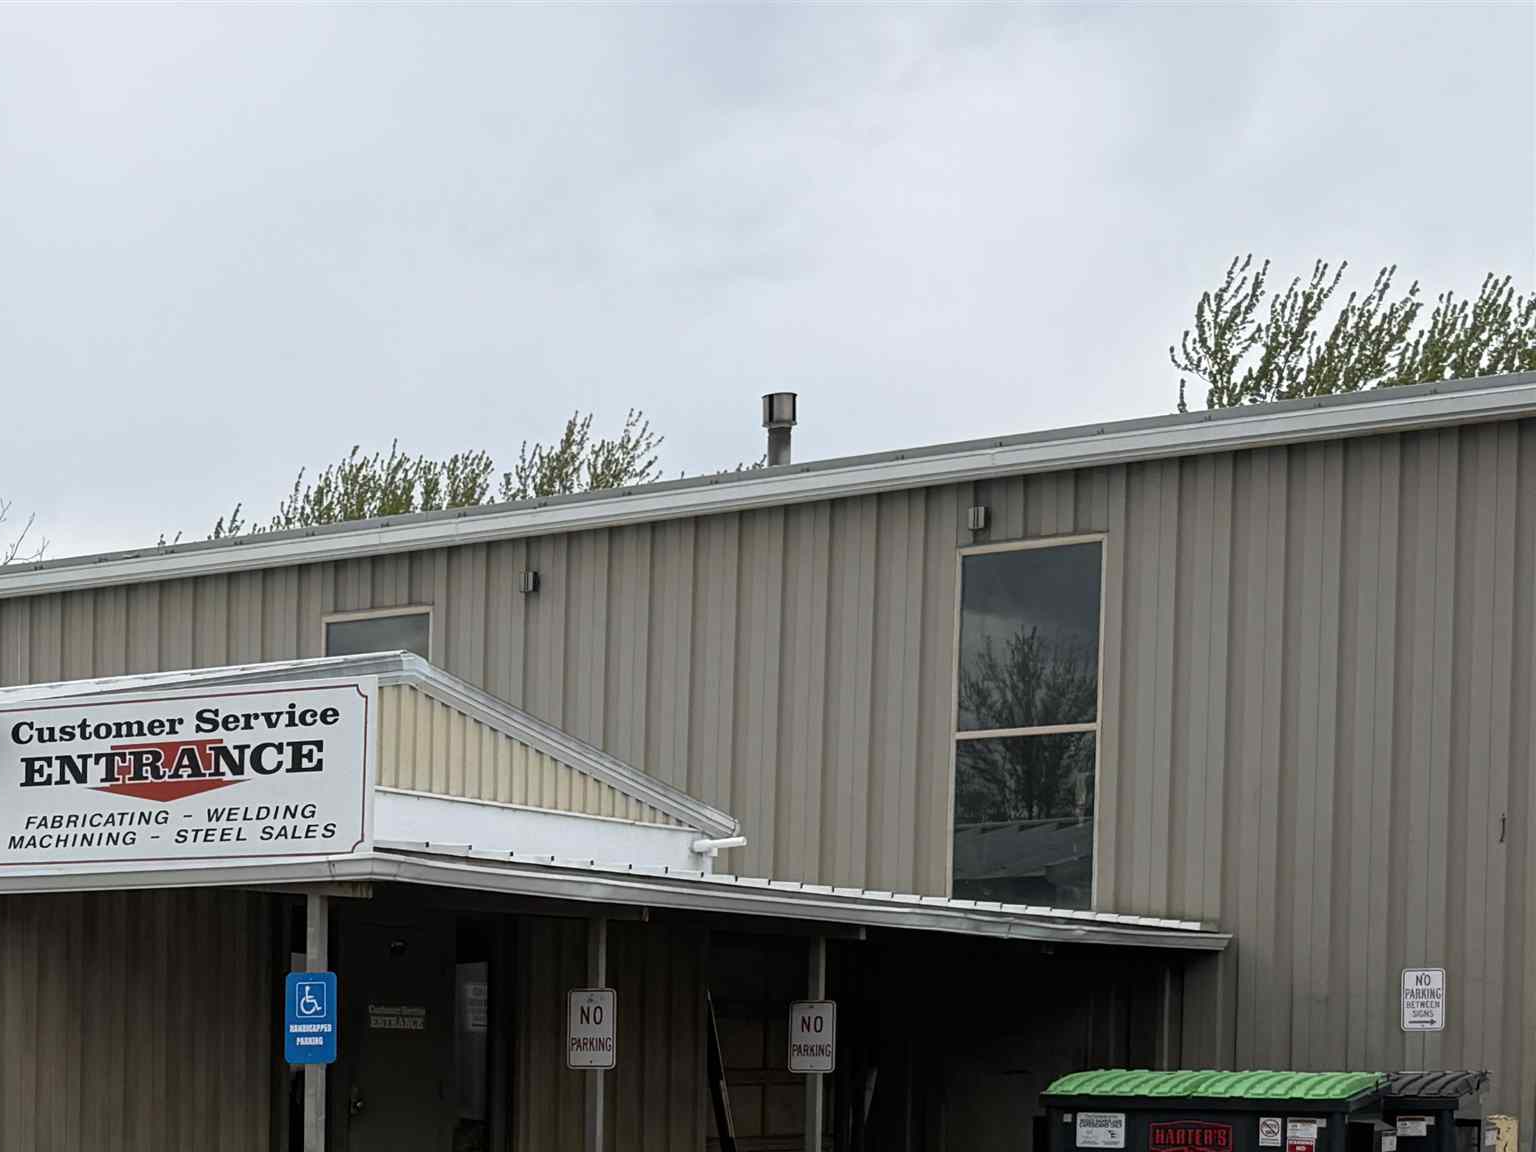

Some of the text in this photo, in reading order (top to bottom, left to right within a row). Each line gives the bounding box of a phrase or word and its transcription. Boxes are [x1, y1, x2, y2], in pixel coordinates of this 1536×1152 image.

[11, 702, 340, 745] Customer Service
[19, 740, 324, 787] ENTRANCE
[25, 810, 170, 830] FABRICATING
[207, 803, 317, 823] WELDING
[8, 831, 137, 850] MACHINING
[175, 826, 247, 844] STEEL
[260, 823, 337, 841] SALES
[1415, 974, 1431, 986] NO
[1404, 988, 1441, 1000] PARKING
[1406, 1000, 1440, 1009] BETWEEN
[580, 1006, 603, 1025] NO
[289, 1023, 332, 1033] HANDICAPPED
[801, 1015, 824, 1033] NO
[296, 1036, 324, 1046] PARKING
[571, 1037, 612, 1052] PARKING
[792, 1043, 832, 1057] PARKING
[1154, 1128, 1227, 1146] HARTER'S
